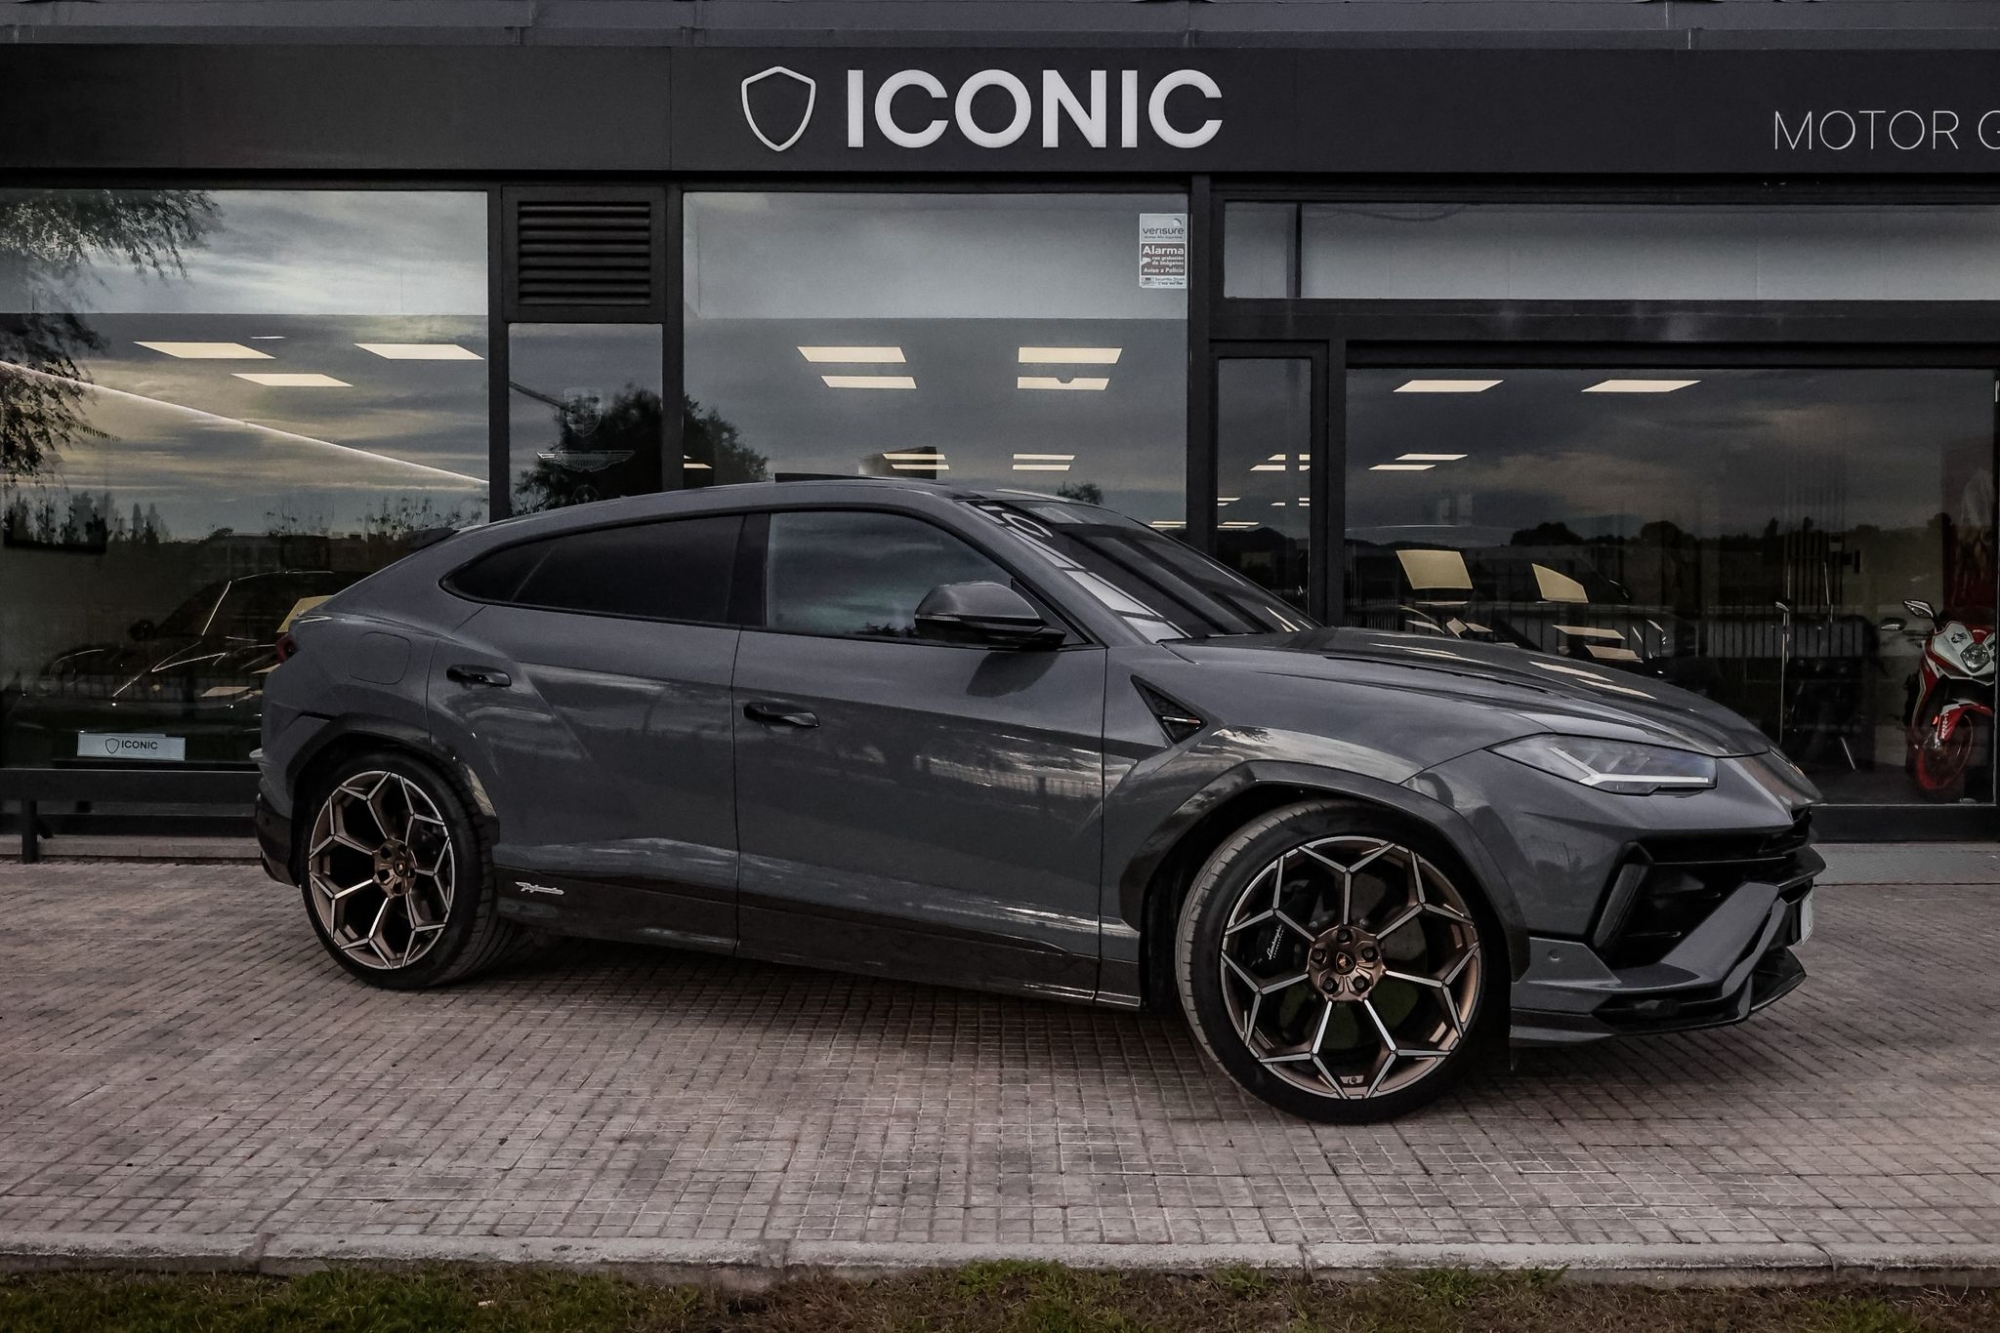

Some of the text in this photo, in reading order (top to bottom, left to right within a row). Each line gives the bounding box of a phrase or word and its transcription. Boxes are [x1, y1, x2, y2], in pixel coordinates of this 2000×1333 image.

[847, 69, 1223, 148] ICONIC
[1774, 110, 1959, 150] MOTOR
[1143, 246, 1184, 255] Alarma
[122, 740, 158, 750] ICONIC
